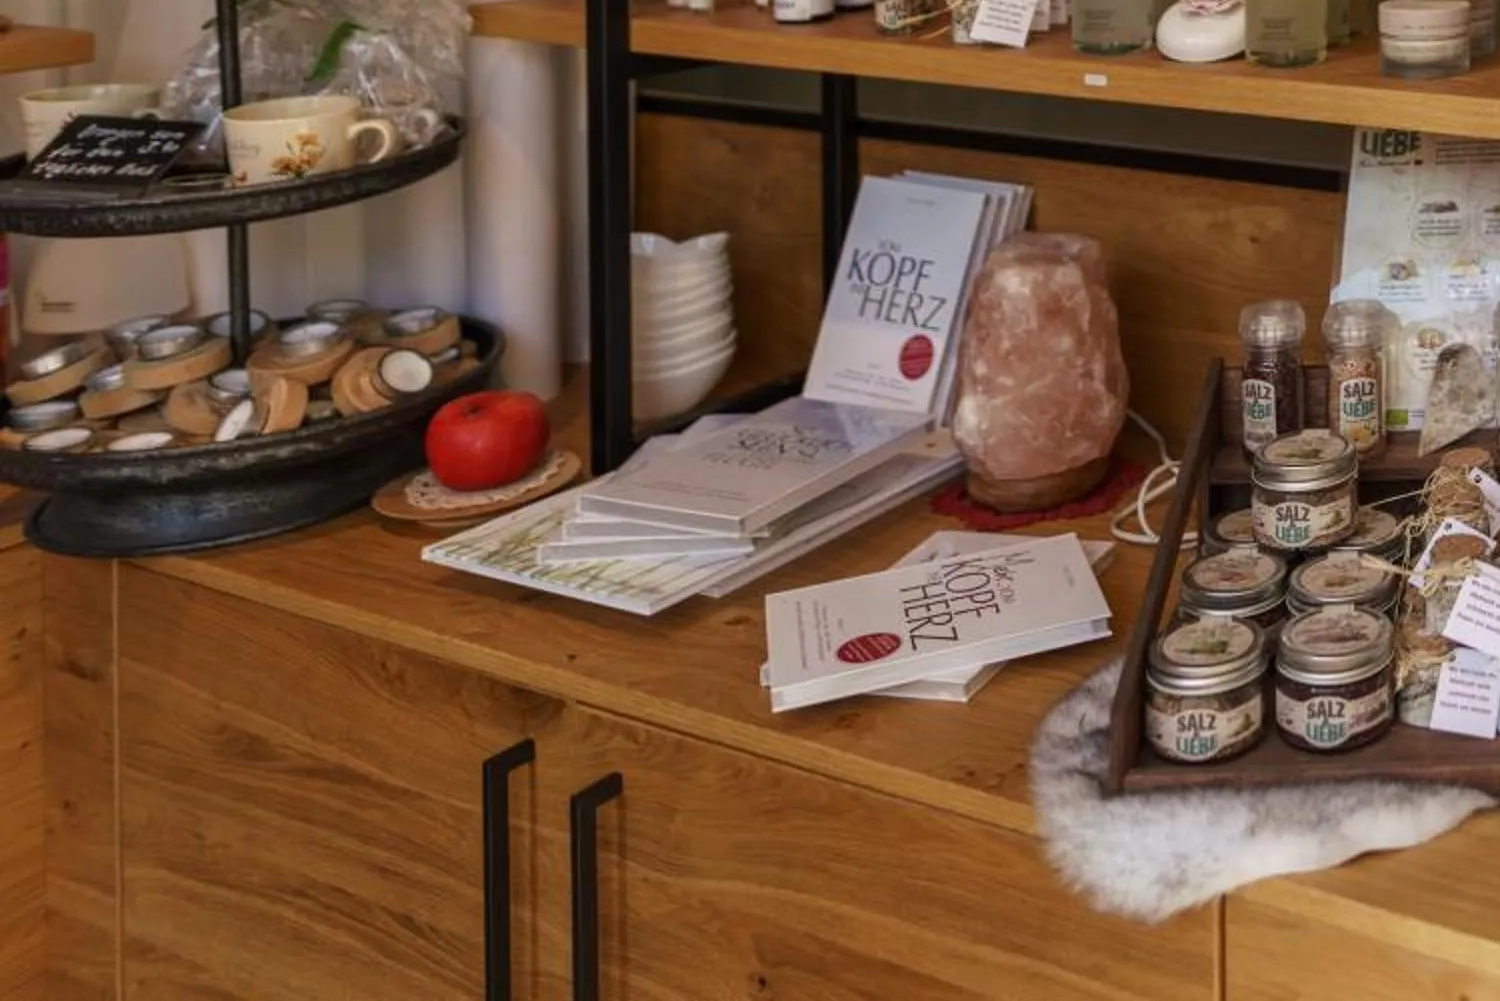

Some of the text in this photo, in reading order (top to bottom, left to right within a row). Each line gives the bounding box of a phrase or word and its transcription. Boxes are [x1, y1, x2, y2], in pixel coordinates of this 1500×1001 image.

[1360, 130, 1422, 157] LIEBE
[846, 248, 936, 292] KOPF
[857, 285, 948, 331] HERZ
[1344, 381, 1375, 399] SALZ
[1275, 506, 1310, 522] SALZ
[941, 558, 1000, 618] KOPF
[900, 581, 958, 651] HERZ
[1176, 713, 1216, 732] SALZ
[1307, 700, 1346, 718] SALZ
